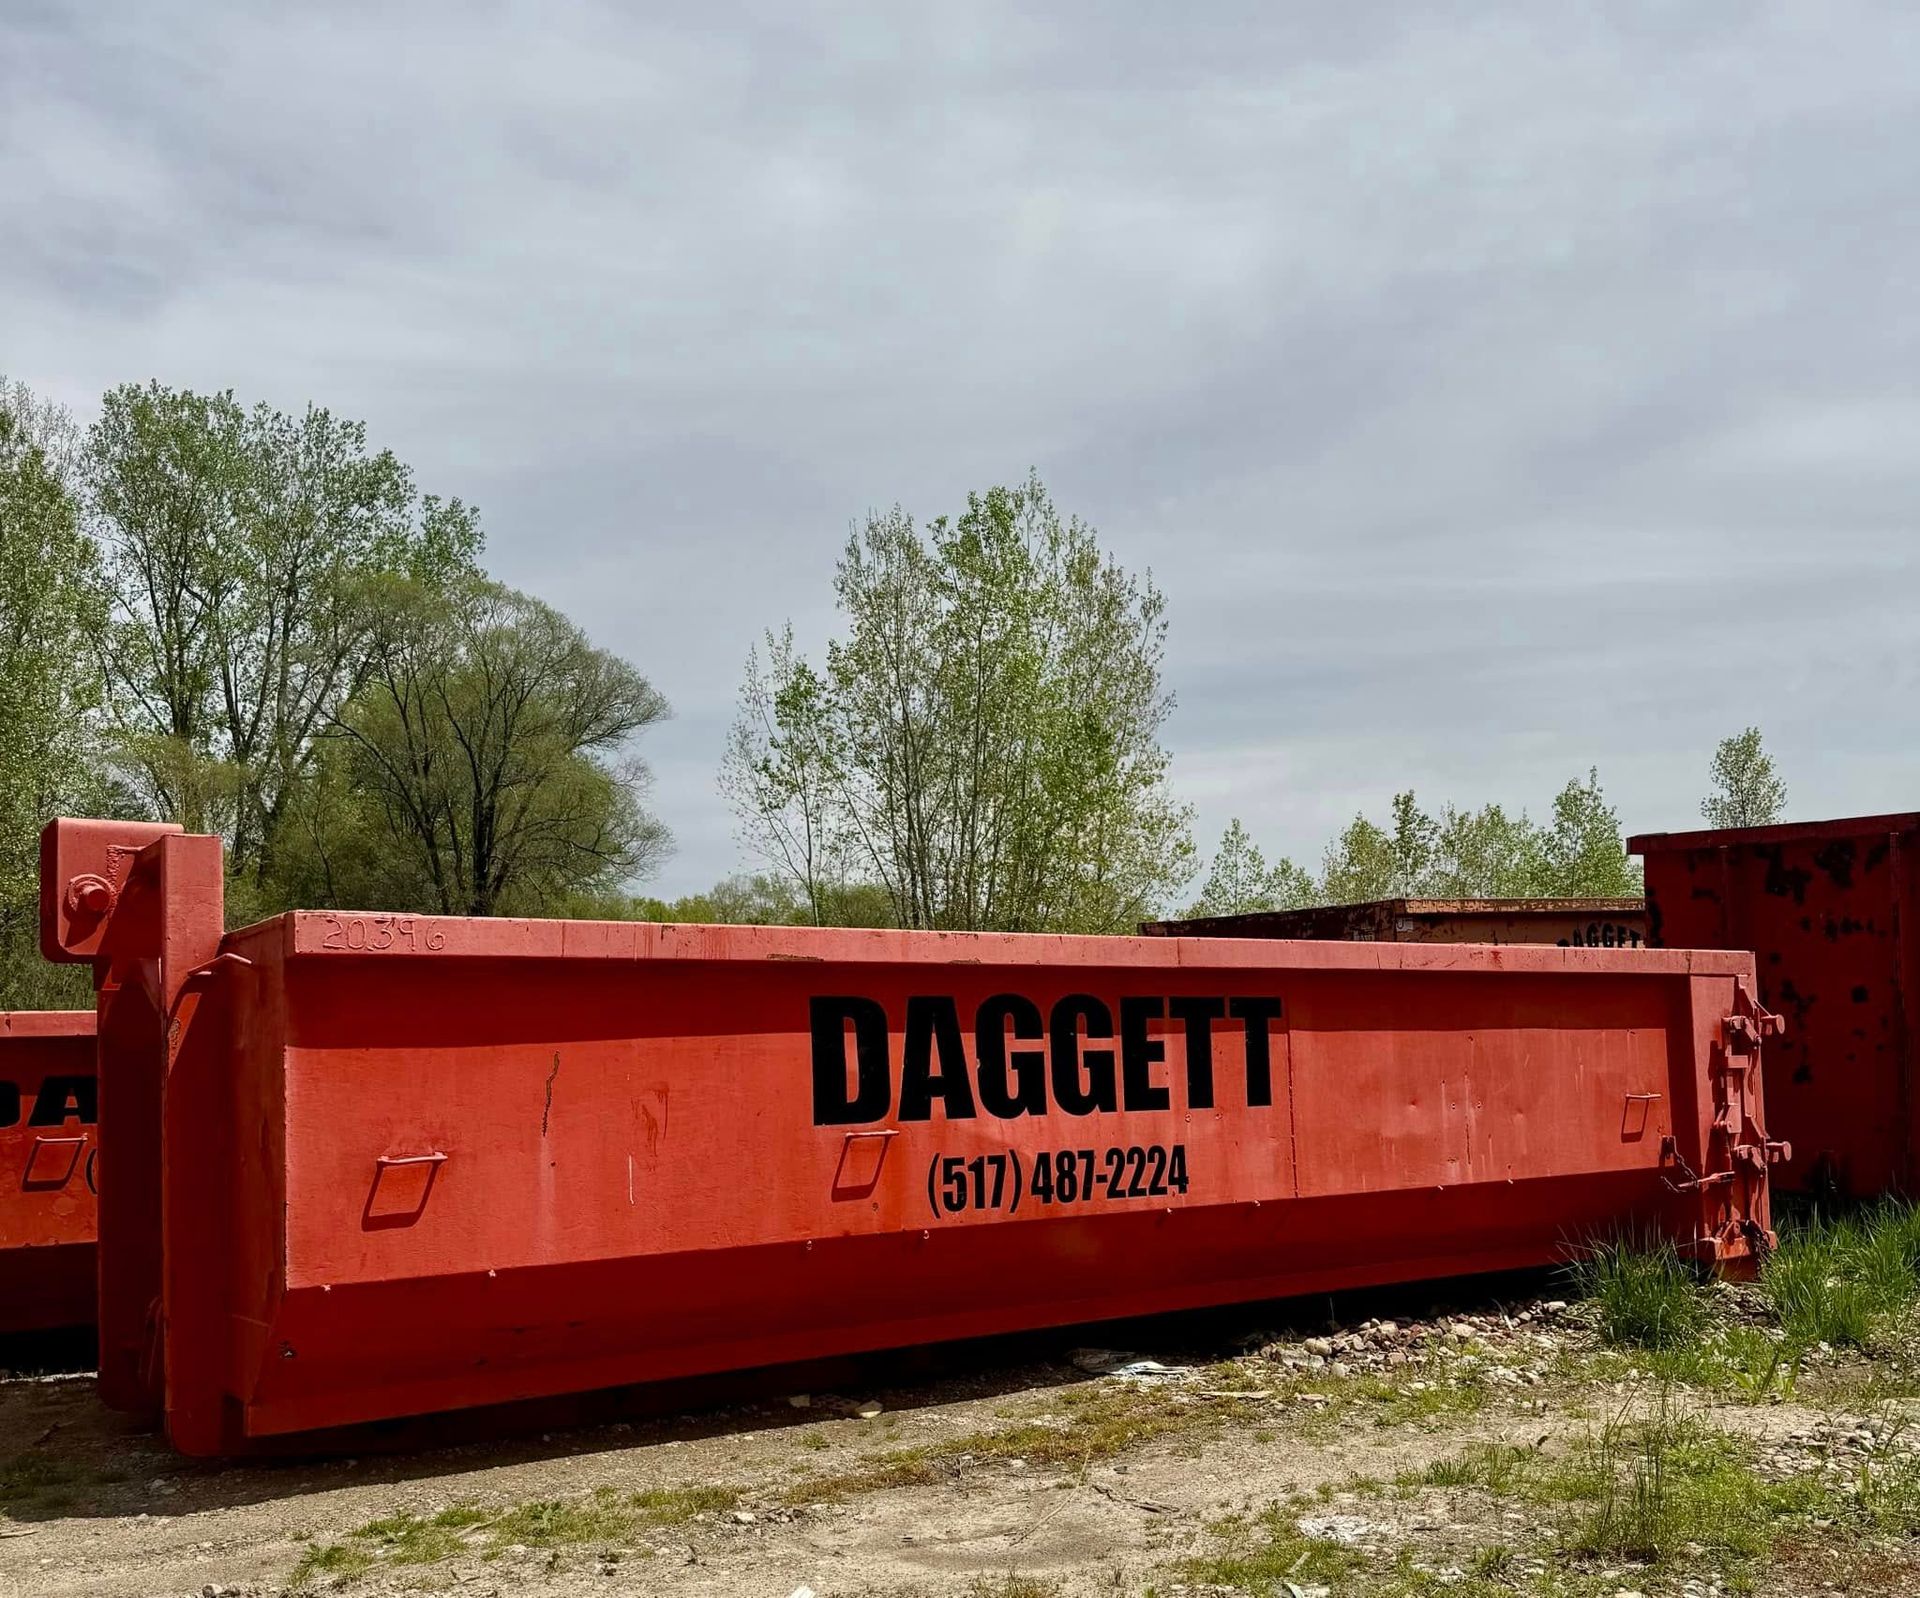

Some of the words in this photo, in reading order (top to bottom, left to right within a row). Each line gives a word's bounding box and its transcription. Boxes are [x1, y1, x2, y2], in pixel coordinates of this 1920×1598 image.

[323, 917, 446, 951] 20396
[809, 993, 1282, 1126] DAGGETT
[927, 1148, 1022, 1219] (517)
[1030, 1144, 1189, 1204] 487-2224
